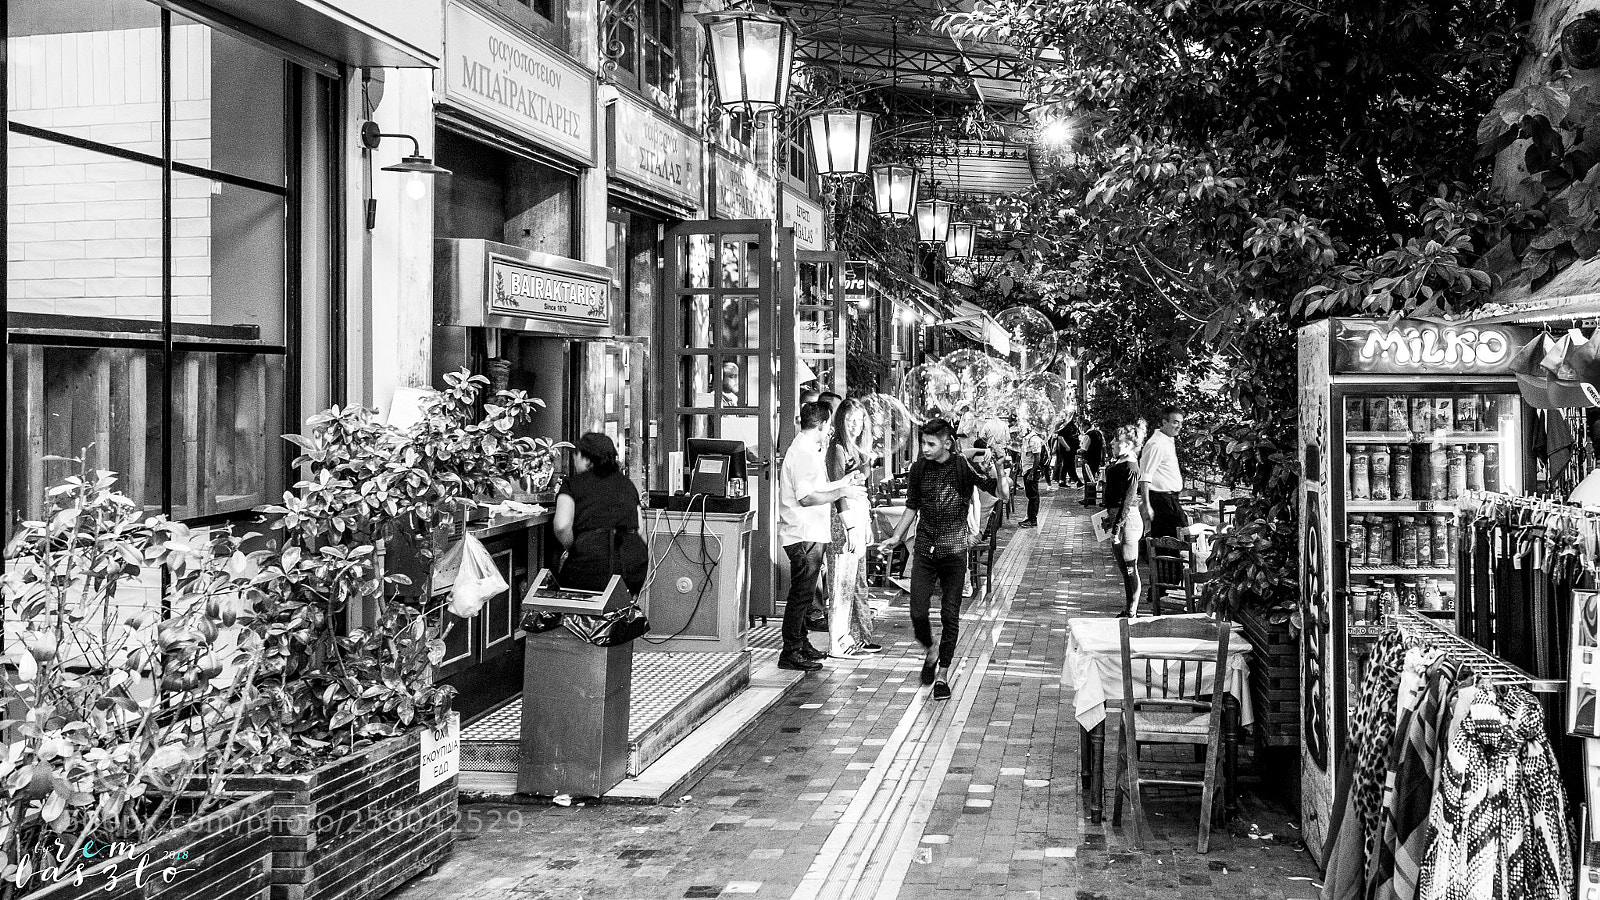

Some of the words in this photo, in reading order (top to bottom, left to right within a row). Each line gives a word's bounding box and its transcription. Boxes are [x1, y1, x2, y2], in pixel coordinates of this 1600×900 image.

[488, 35, 562, 91] φαγοποτειον
[461, 54, 581, 140] ΜΠΑΪΡΑΚΤΑΡΗΣ
[510, 271, 597, 307] BAIRAKTARIS
[543, 302, 556, 311] Since
[422, 740, 459, 767] ΣΚΟΥΠΙΔΙΑ
[433, 760, 449, 778] ΕΔΩ
